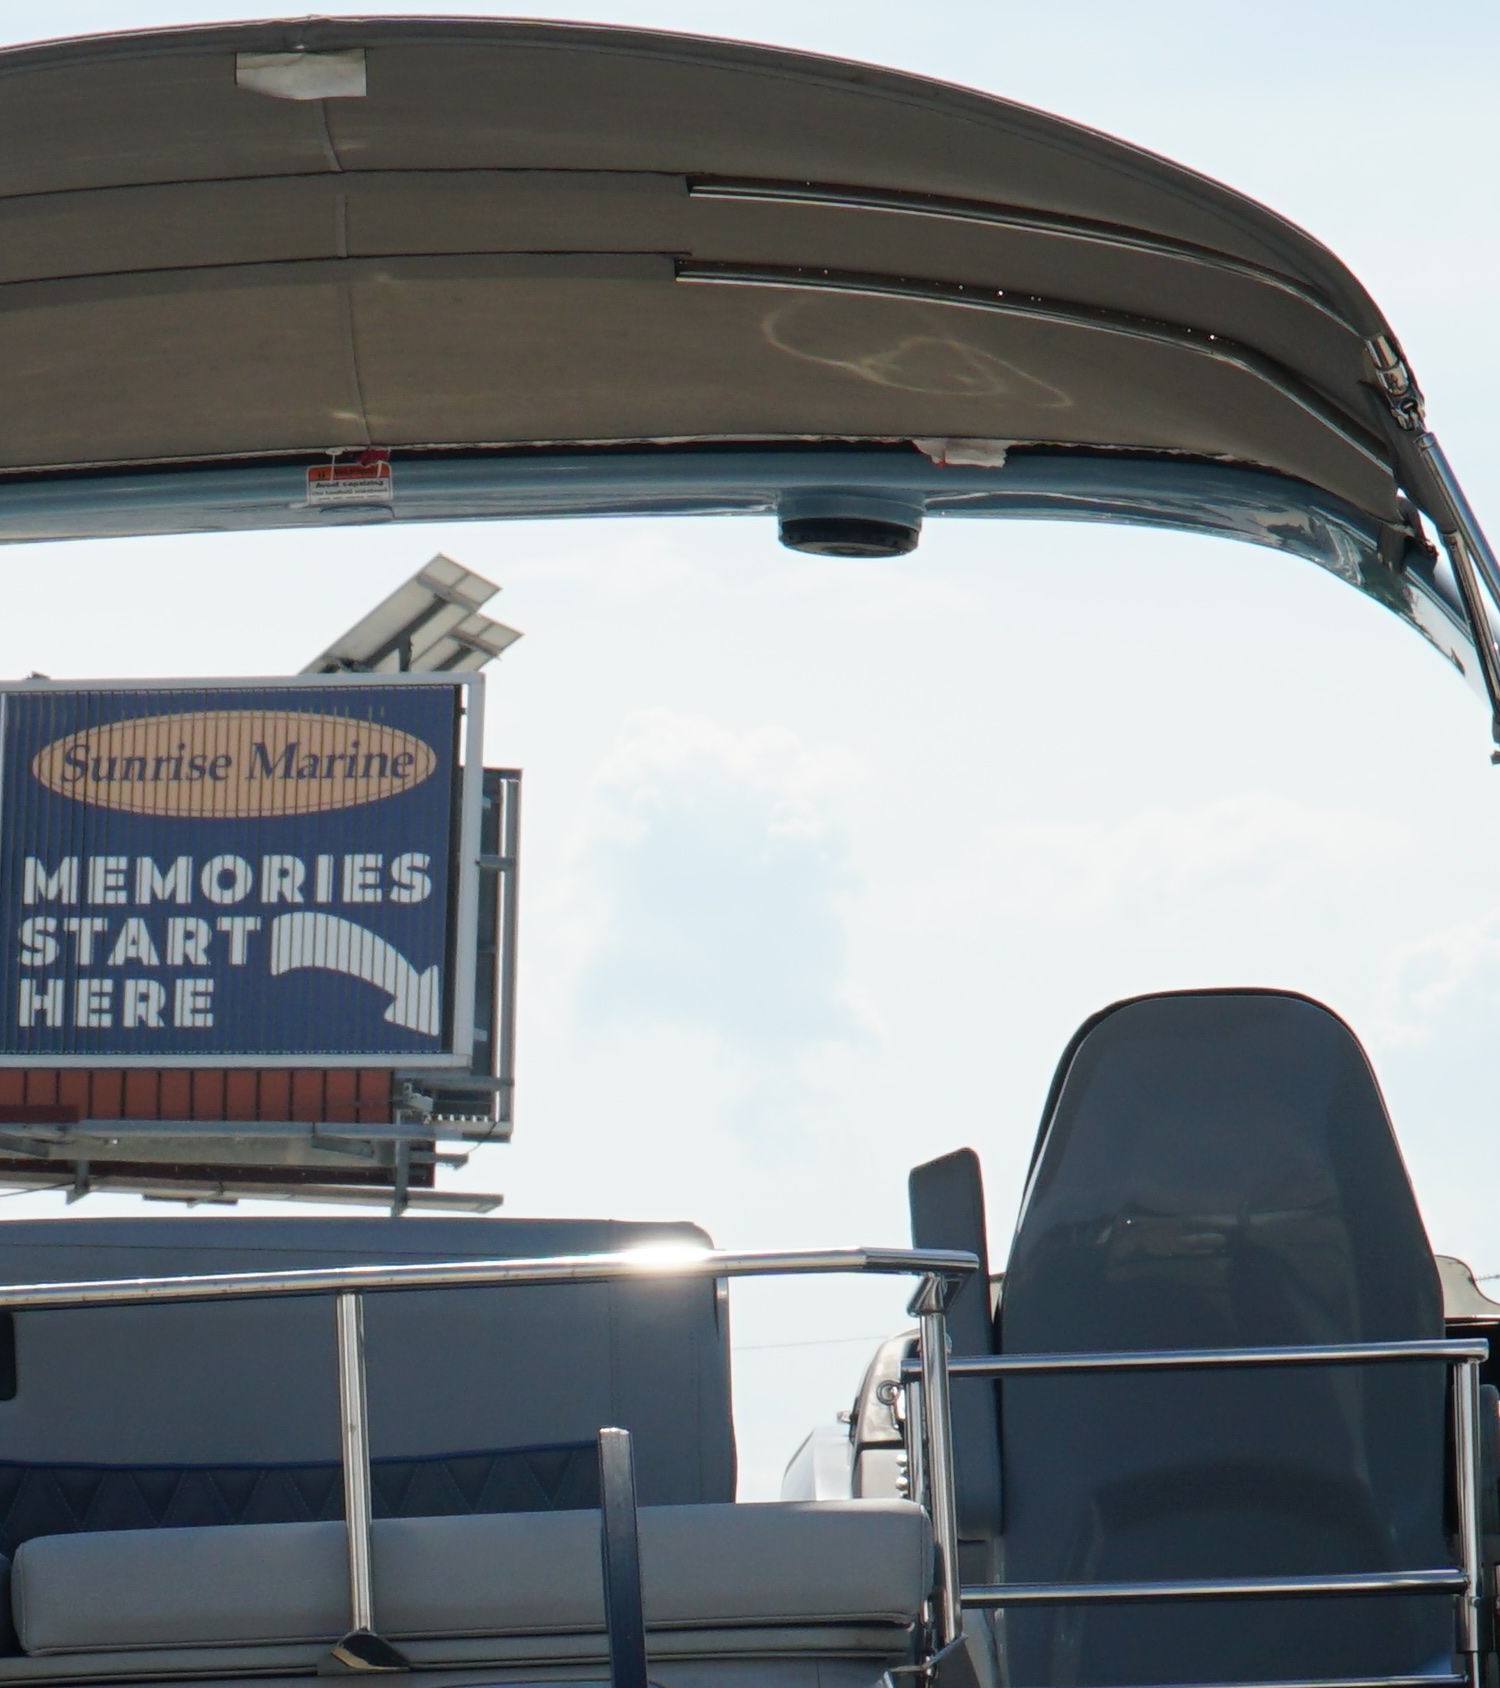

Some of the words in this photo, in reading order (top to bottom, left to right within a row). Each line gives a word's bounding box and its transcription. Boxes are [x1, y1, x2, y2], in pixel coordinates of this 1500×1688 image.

[61, 743, 232, 784] Sunrise
[246, 741, 414, 780] Marine
[23, 852, 432, 905] MEMORIES
[17, 916, 260, 966] START
[18, 978, 214, 1027] HERE
